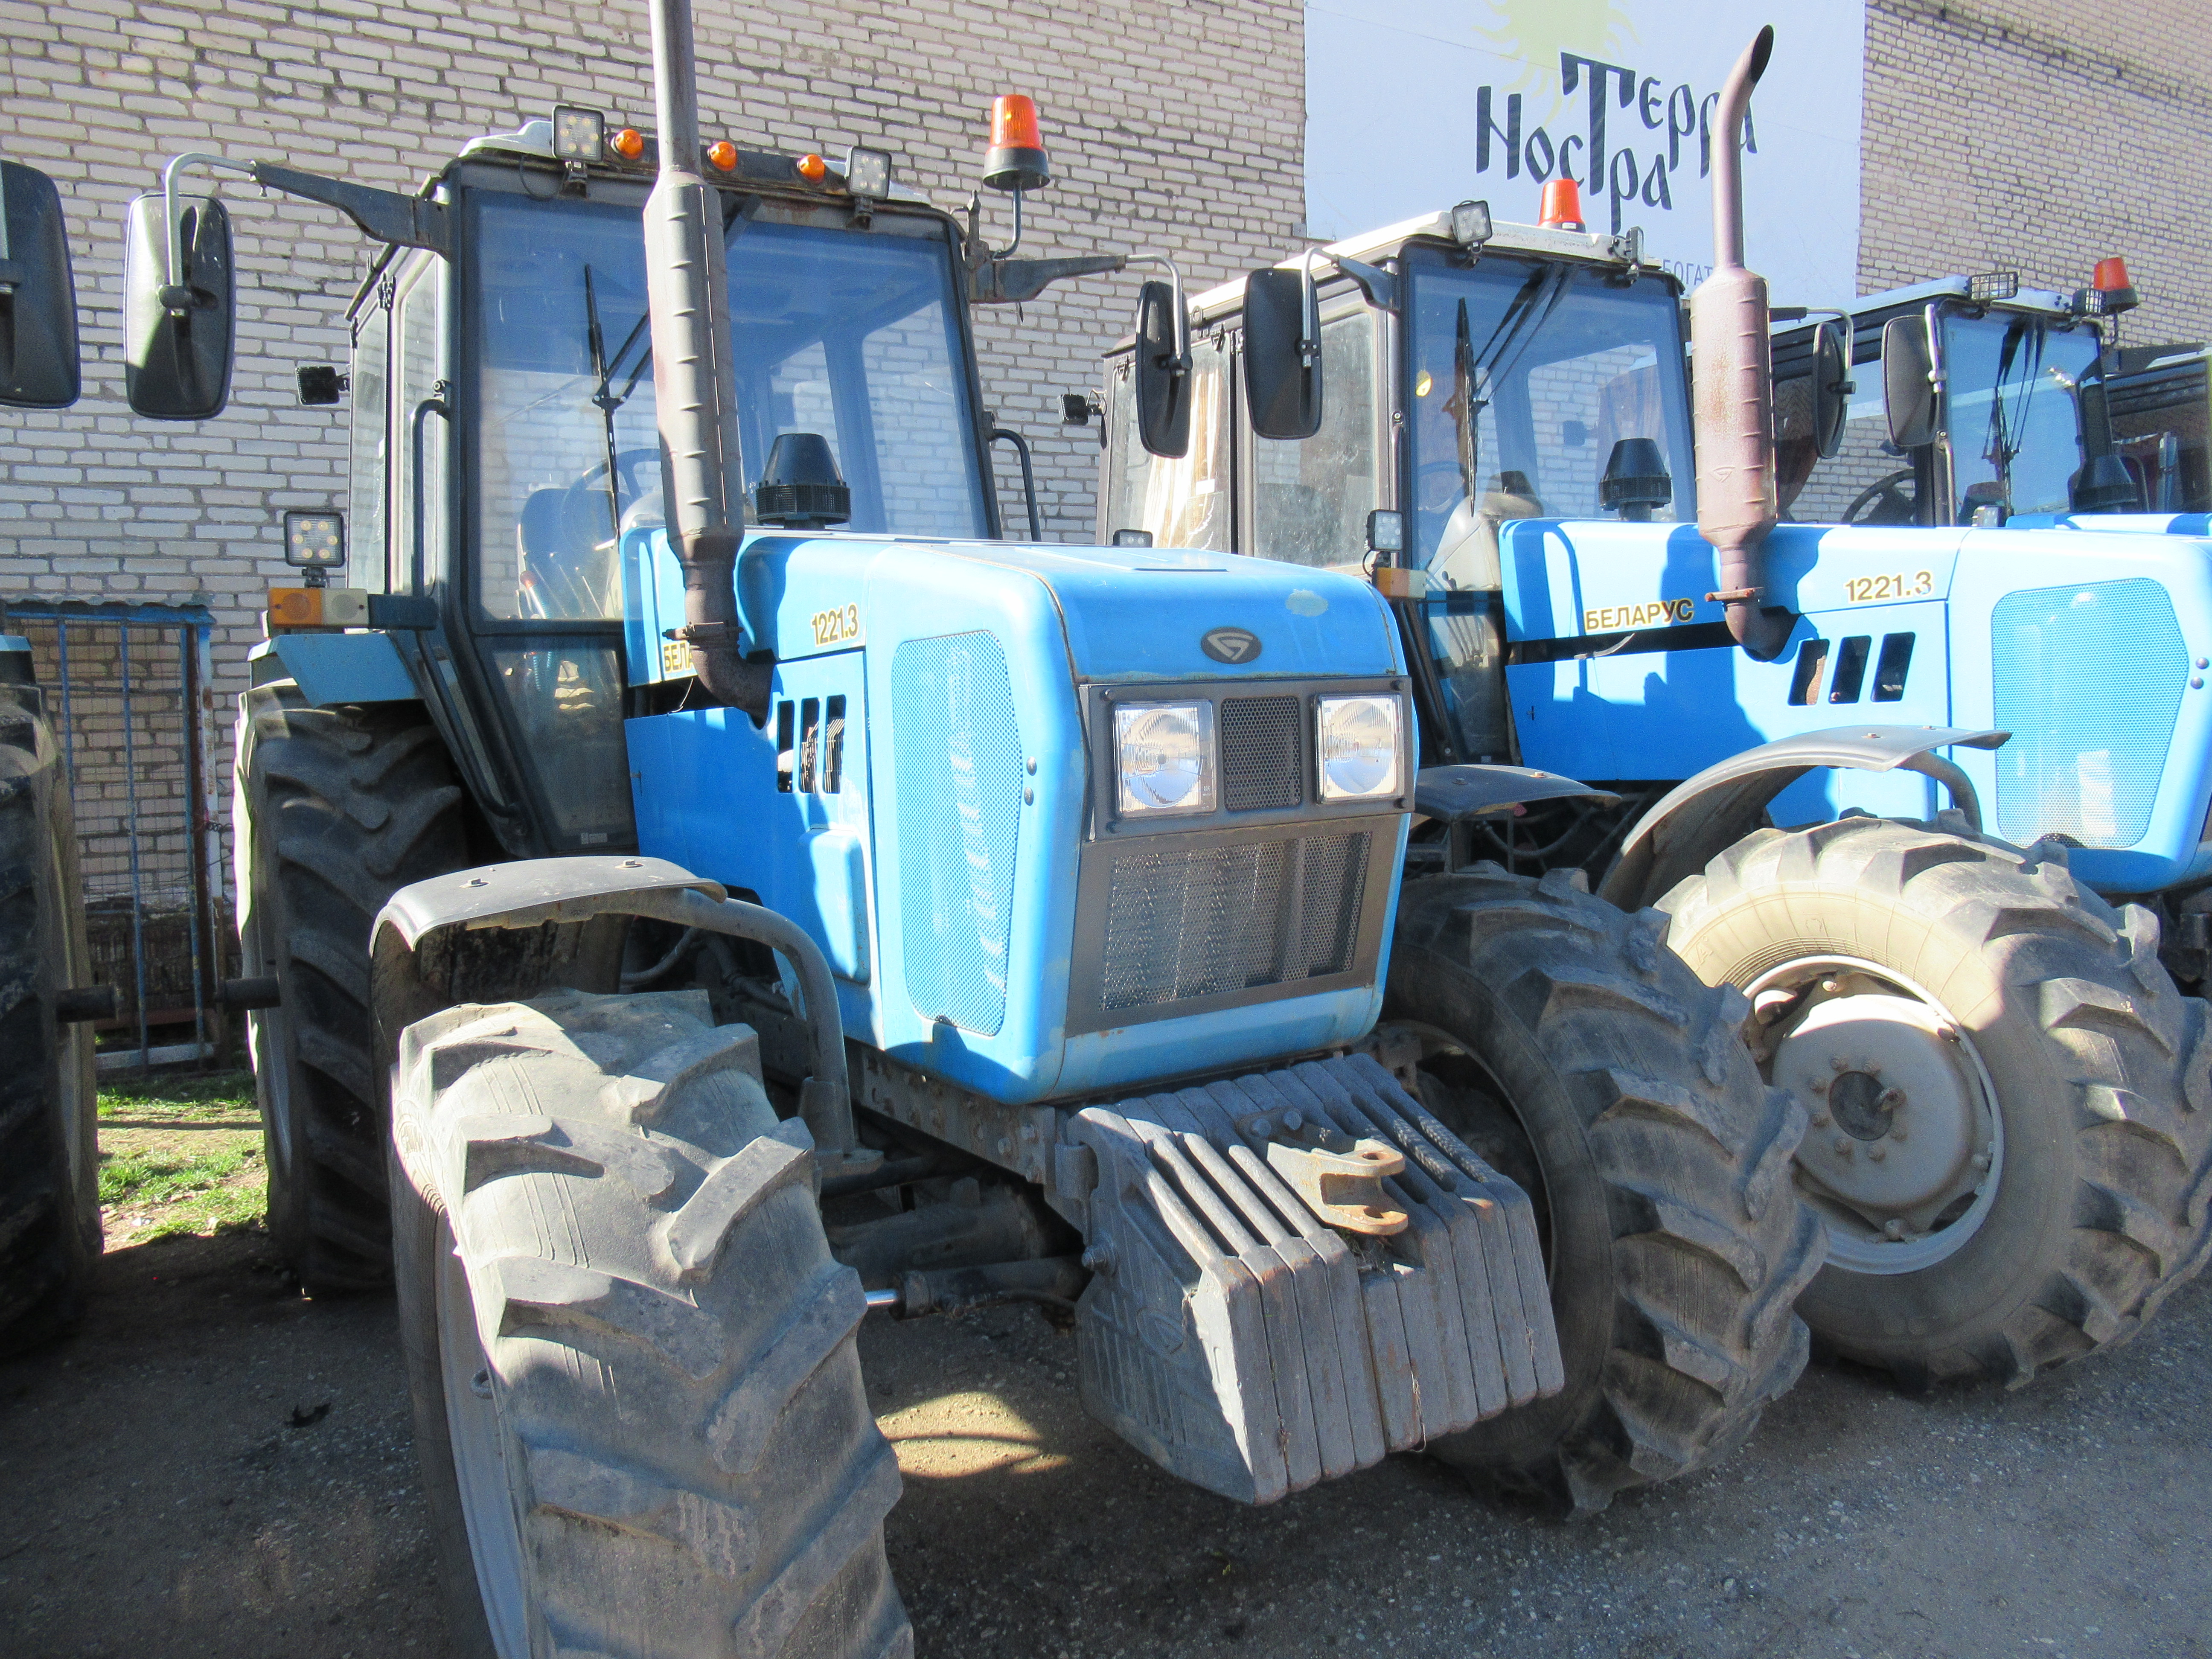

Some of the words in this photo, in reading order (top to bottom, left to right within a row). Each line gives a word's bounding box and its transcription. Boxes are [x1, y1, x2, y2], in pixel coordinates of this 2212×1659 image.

[1663, 259, 1713, 285] БОГАТ
[1845, 571, 1932, 602] 1221.3
[811, 603, 859, 646] 1221.3
[1584, 598, 1694, 630] БЕЛАРУС
